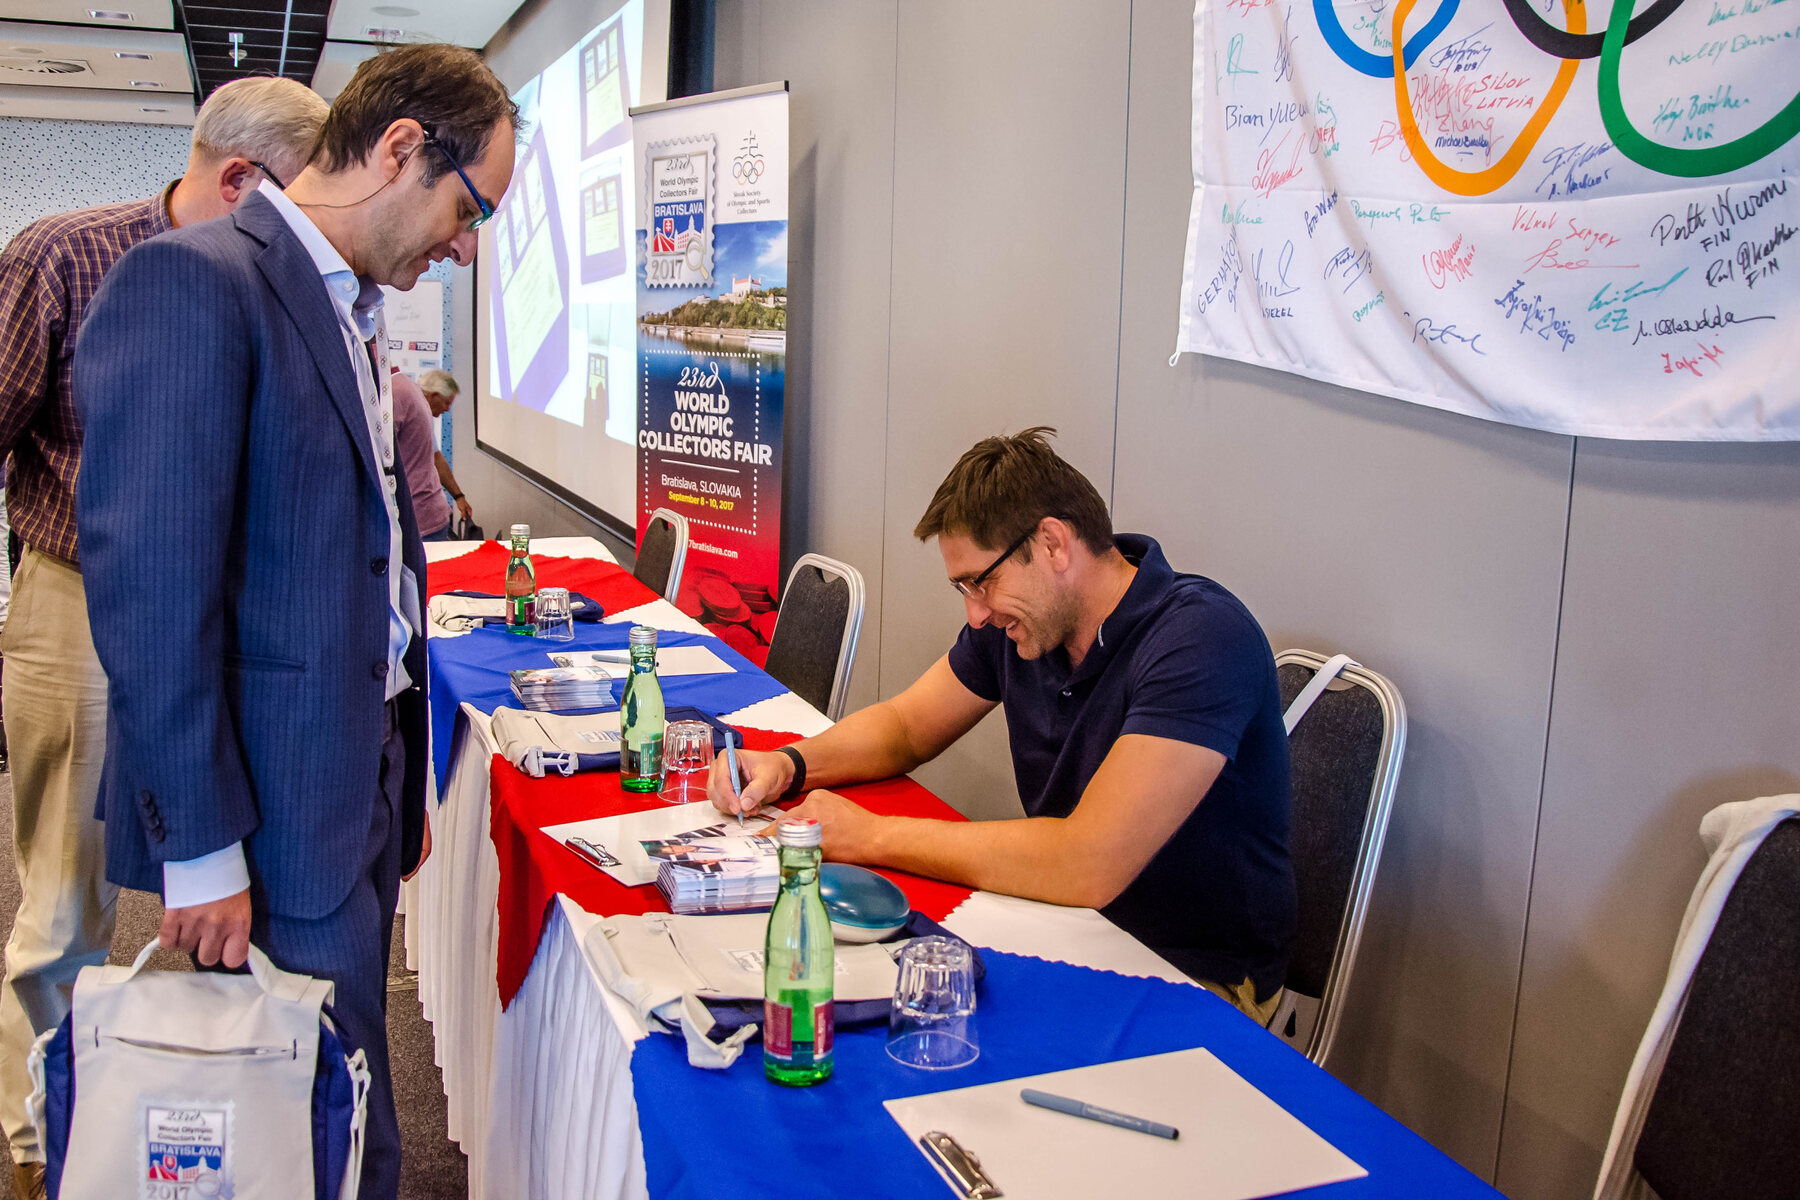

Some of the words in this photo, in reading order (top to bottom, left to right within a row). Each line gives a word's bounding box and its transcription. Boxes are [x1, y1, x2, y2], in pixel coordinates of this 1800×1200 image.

[660, 178, 676, 187] World
[677, 176, 699, 187] Olympic
[660, 189, 687, 198] Collectors
[688, 187, 698, 196] Fair
[654, 202, 704, 217] BRATISLAVA
[1700, 228, 1731, 252] FIN
[651, 259, 684, 280] 2017
[677, 361, 726, 396] 23rd
[674, 390, 731, 415] WORLD
[670, 411, 734, 438] OLYMPIC
[638, 429, 732, 461] COLLECTORS
[734, 440, 773, 466] FAIR
[661, 473, 699, 492] Bratislava,
[699, 480, 742, 499] SLOVAKIA
[668, 490, 700, 505] September
[700, 496, 705, 506] 8
[709, 498, 719, 510] 10,
[719, 500, 735, 511] 2017
[688, 539, 739, 559] 7bratislava.com
[150, 1142, 221, 1157] BRATISLAVA
[146, 1183, 191, 1200] 2017
